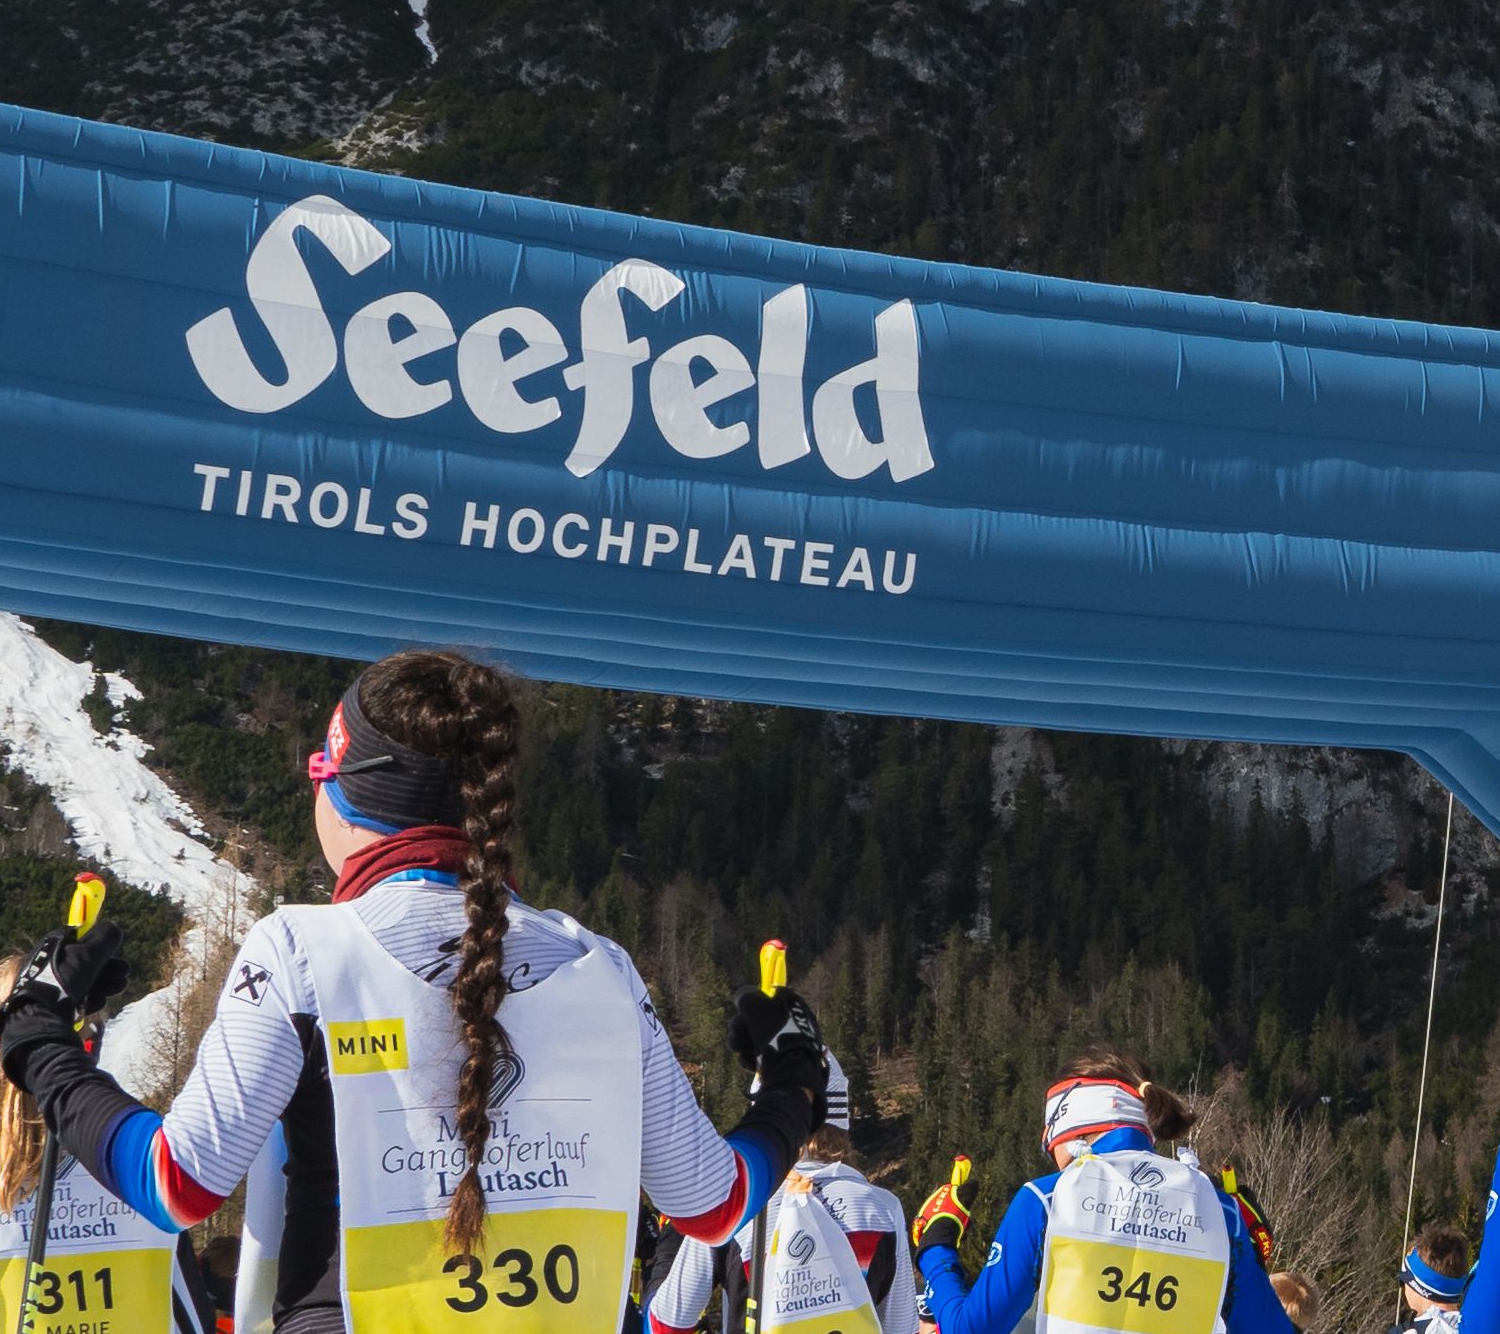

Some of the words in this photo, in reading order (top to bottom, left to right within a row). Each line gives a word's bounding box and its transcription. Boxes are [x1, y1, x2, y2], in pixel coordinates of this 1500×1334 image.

[184, 193, 935, 483] Seefeld
[193, 463, 429, 540] TIROLS
[460, 500, 918, 595] HOCHPLATEAU
[338, 1034, 399, 1056] MINI
[437, 1110, 511, 1143] Mni
[437, 1162, 569, 1198] Lutasch
[1115, 1186, 1160, 1206] Mini
[22, 1218, 117, 1243] Lutasch
[1110, 1218, 1187, 1244] Leutasch
[36, 1268, 114, 1315] 311
[441, 1244, 580, 1313] 330
[1097, 1266, 1180, 1312] 346
[775, 1289, 842, 1314] Leutasch
